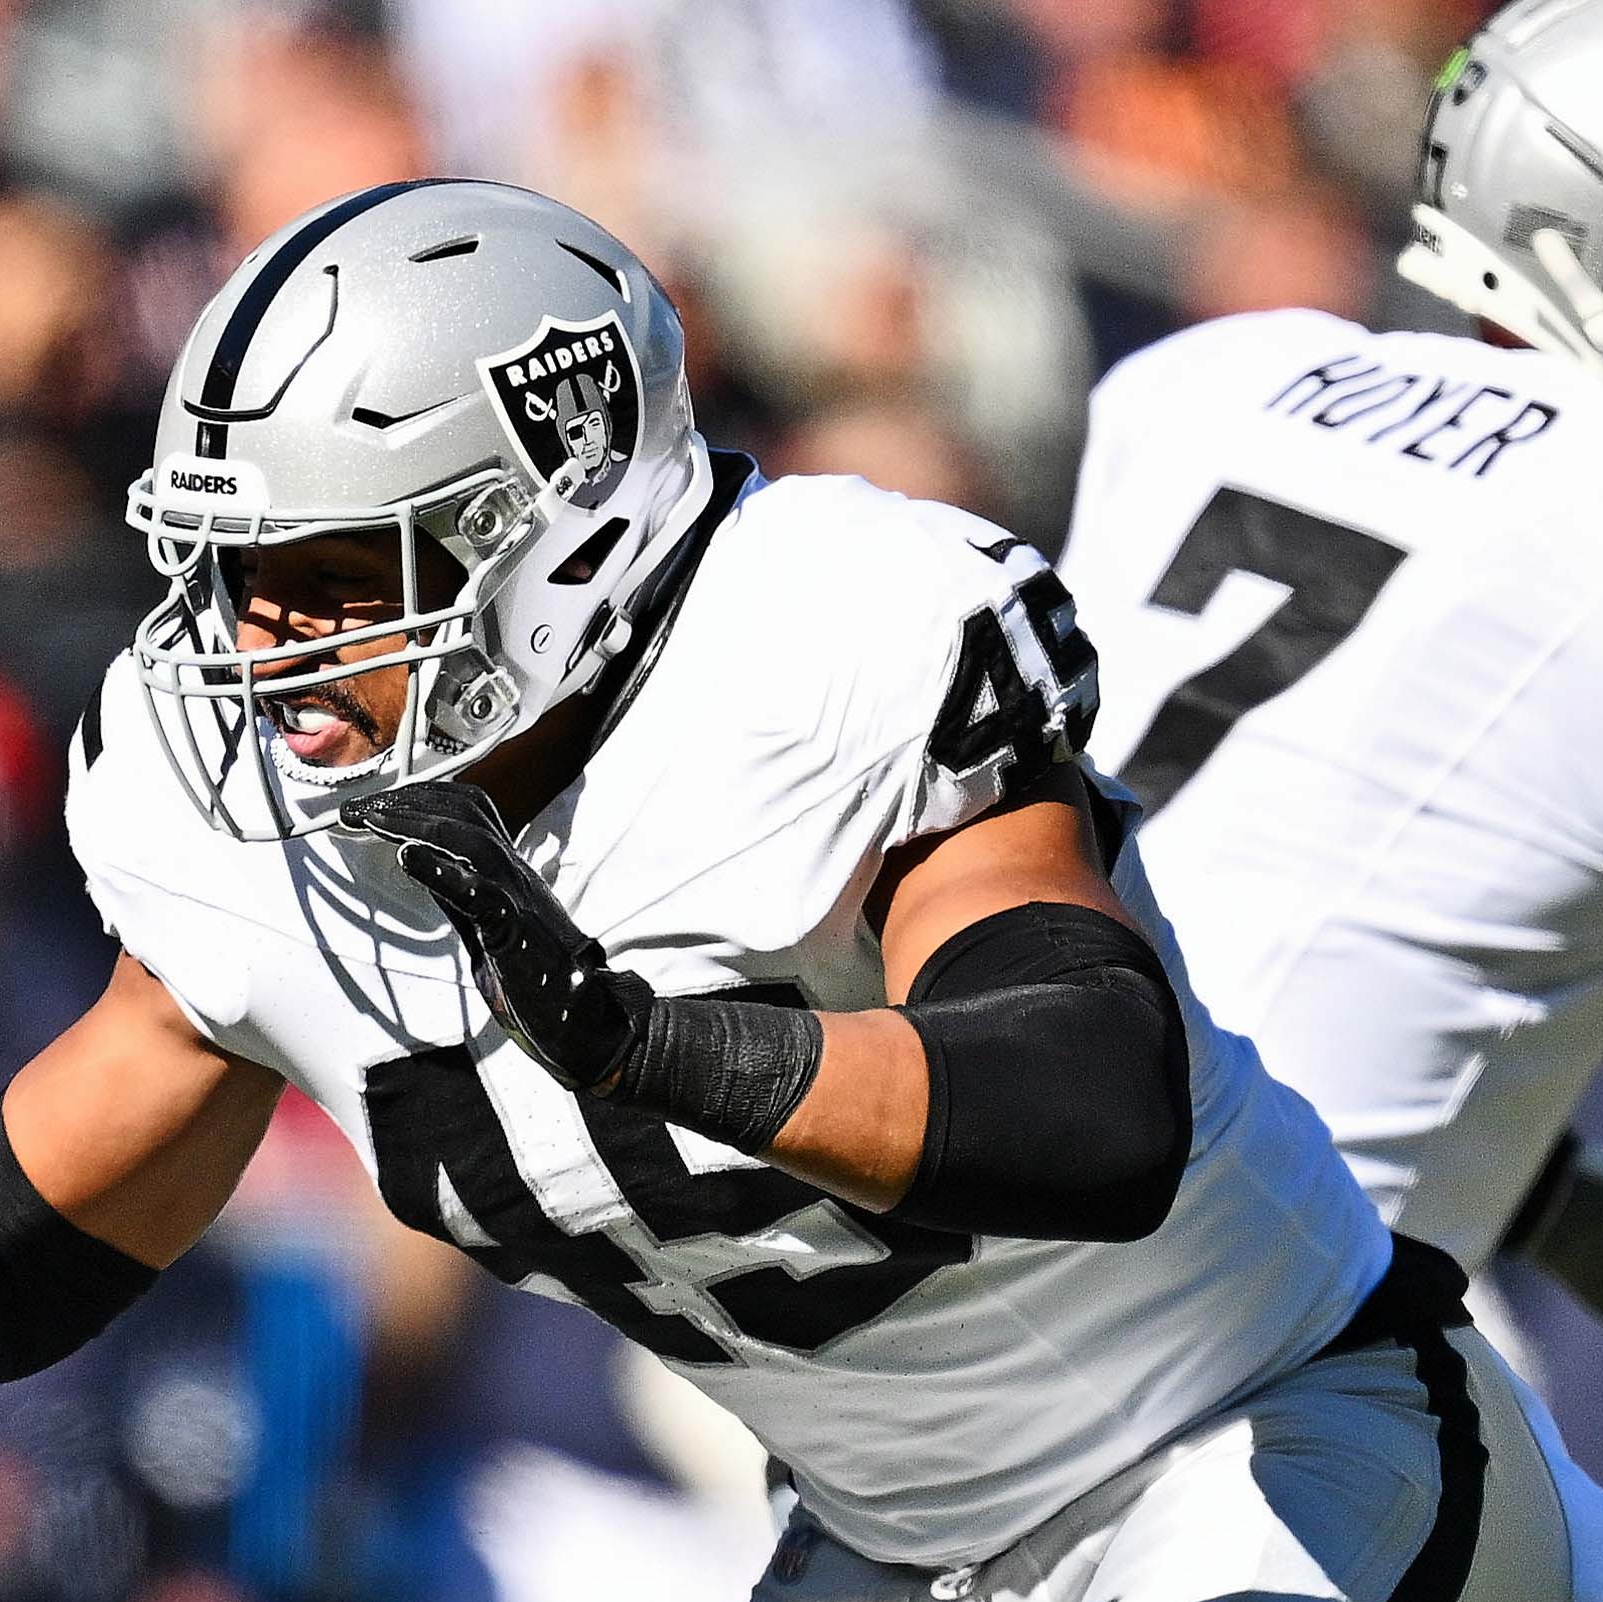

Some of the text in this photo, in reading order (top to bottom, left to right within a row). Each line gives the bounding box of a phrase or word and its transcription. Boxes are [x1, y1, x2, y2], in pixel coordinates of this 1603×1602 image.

[505, 330, 615, 388] RAIDERS
[1262, 354, 1561, 478] HOYER
[170, 469, 238, 496] RAIDERS
[1113, 482, 1412, 834] 7
